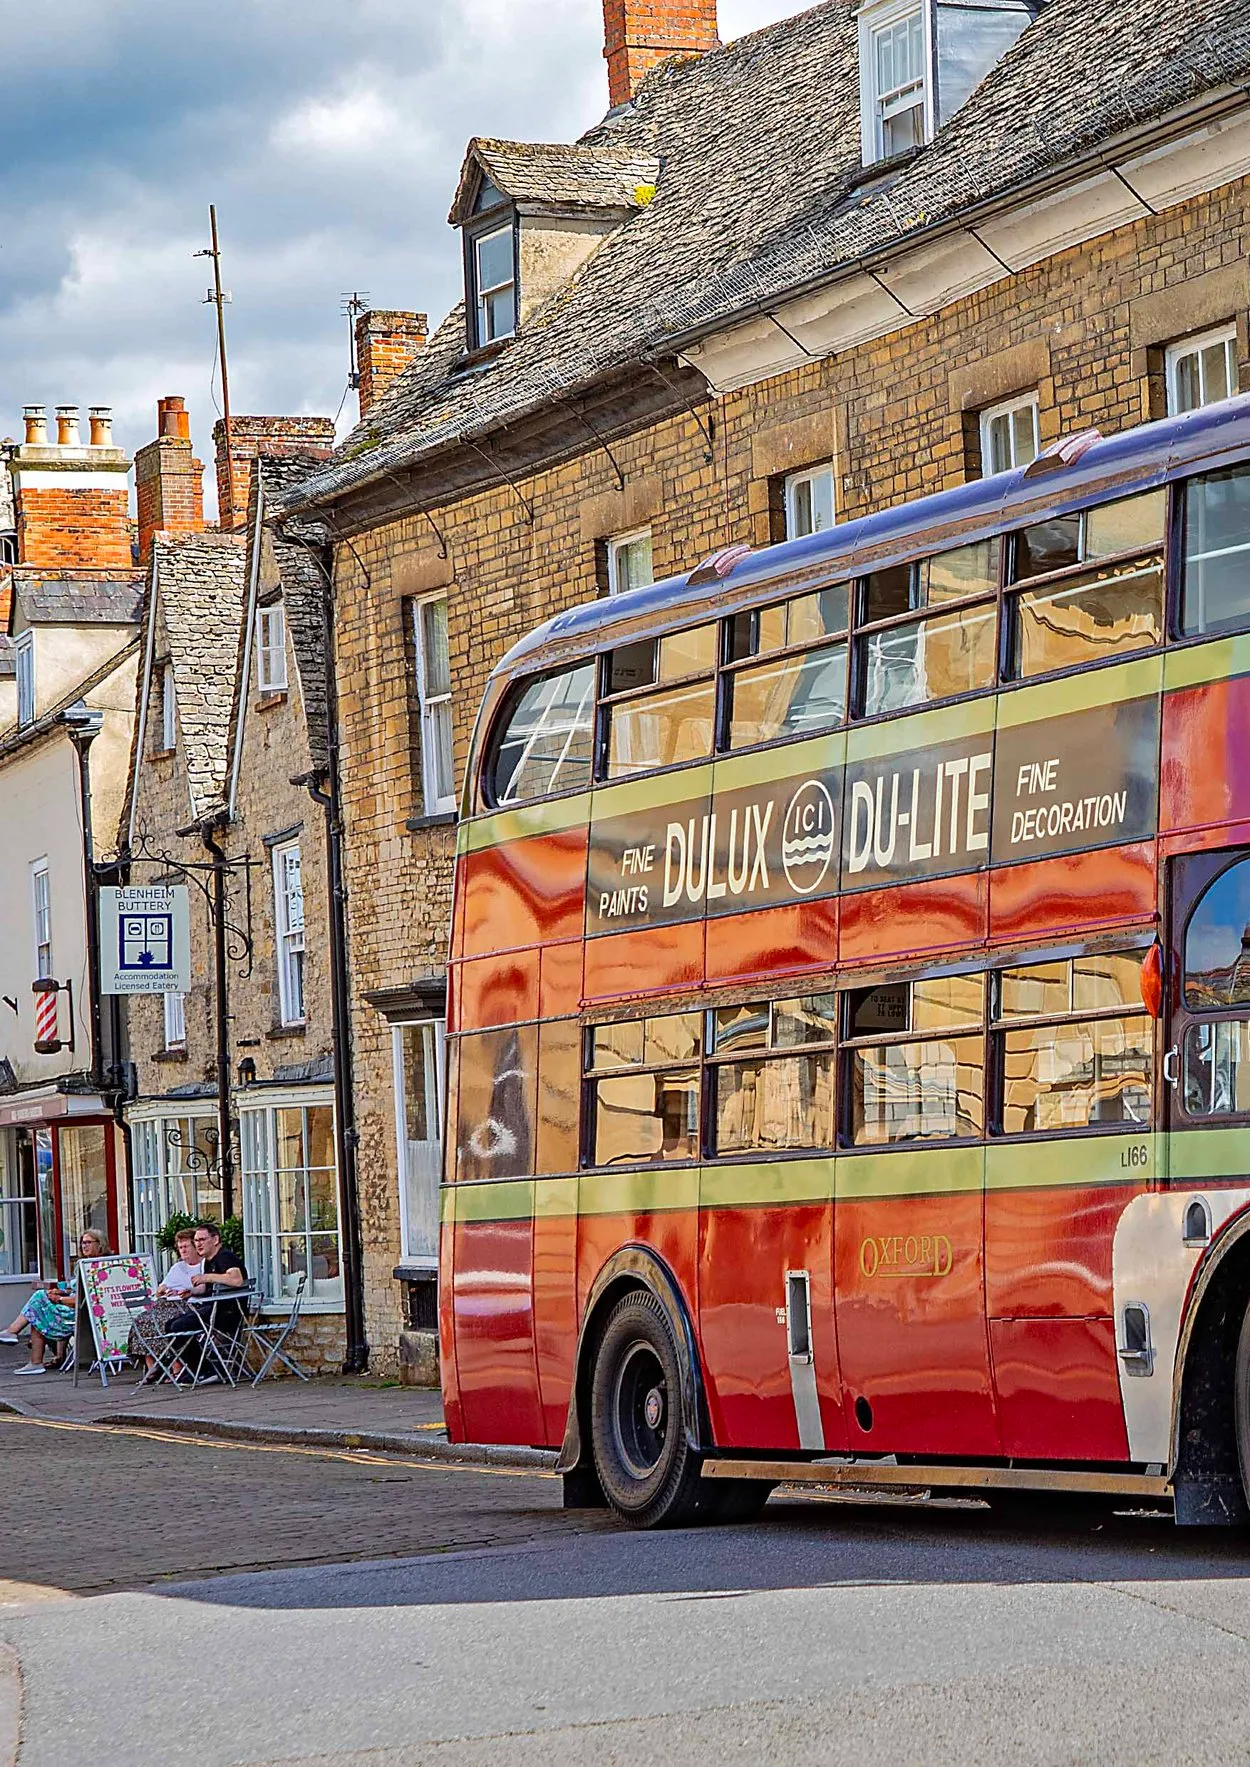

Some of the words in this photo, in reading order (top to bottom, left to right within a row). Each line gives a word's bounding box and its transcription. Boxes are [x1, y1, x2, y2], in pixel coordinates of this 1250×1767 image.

[1015, 757, 1060, 797] FINE
[794, 801, 824, 836] ICI
[849, 752, 992, 874] DU-LITE
[1010, 790, 1127, 844] DECORATION
[620, 843, 655, 877] FINE
[662, 799, 776, 908] DULUX
[115, 889, 175, 899] BLENHEIM
[118, 901, 171, 911] BUTTERY
[598, 885, 649, 920] PAINTS
[114, 973, 179, 981] Accommodation
[114, 982, 150, 990] Licensed
[152, 982, 179, 990] Eatery
[859, 1235, 954, 1278] OXFORD
[775, 1307, 787, 1316] FUEL
